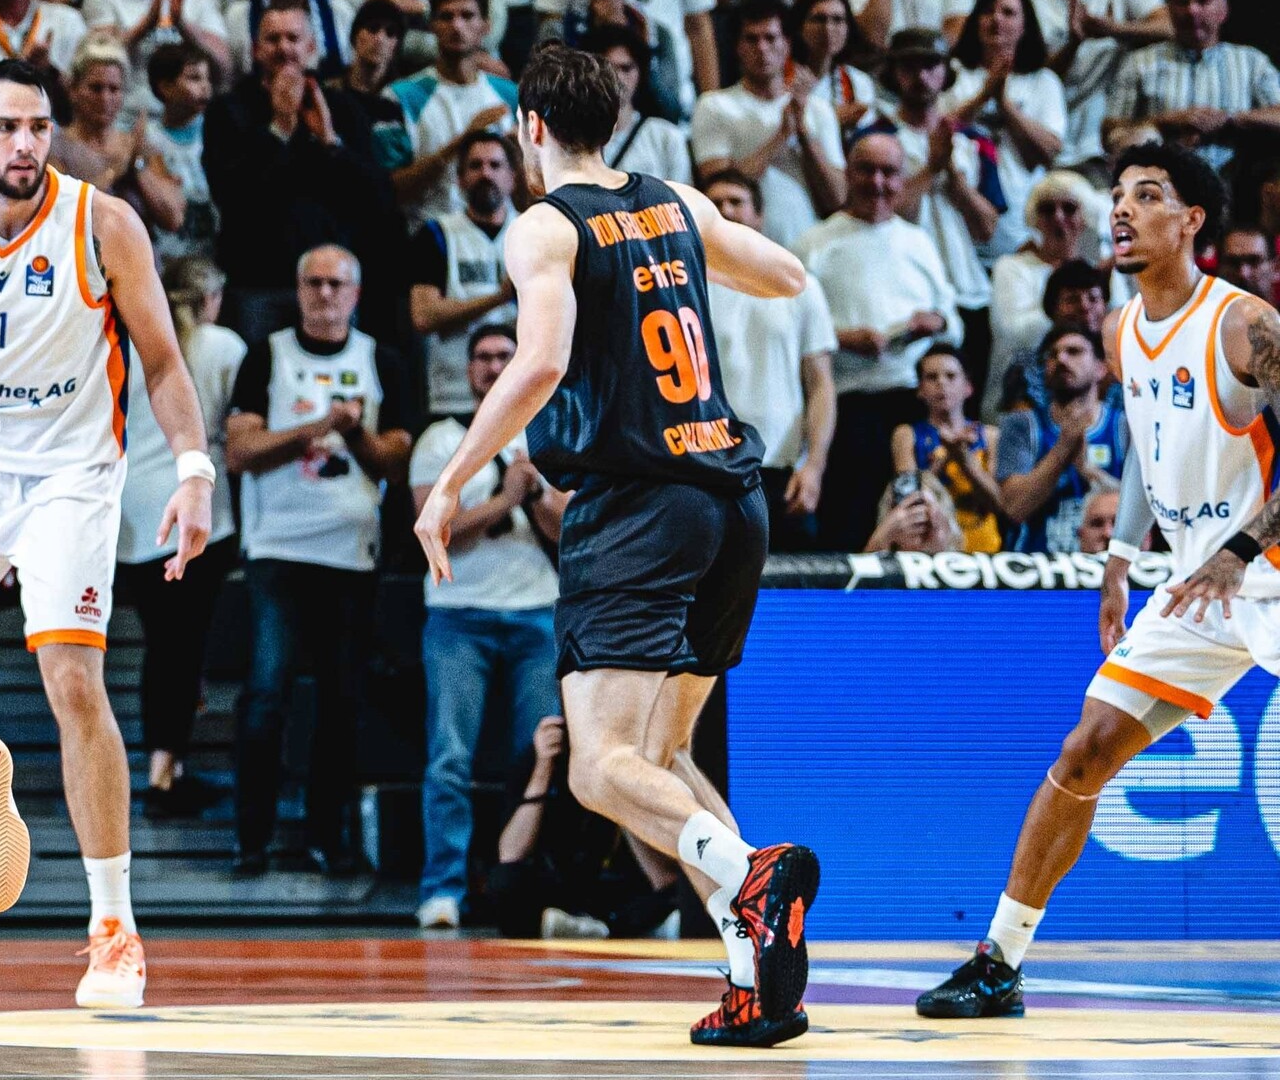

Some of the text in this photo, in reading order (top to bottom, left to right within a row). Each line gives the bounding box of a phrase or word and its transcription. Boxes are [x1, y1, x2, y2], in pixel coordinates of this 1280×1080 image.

[633, 255, 689, 293] eins
[641, 306, 712, 404] 90
[45, 377, 77, 399] AG
[1197, 501, 1230, 519] AG
